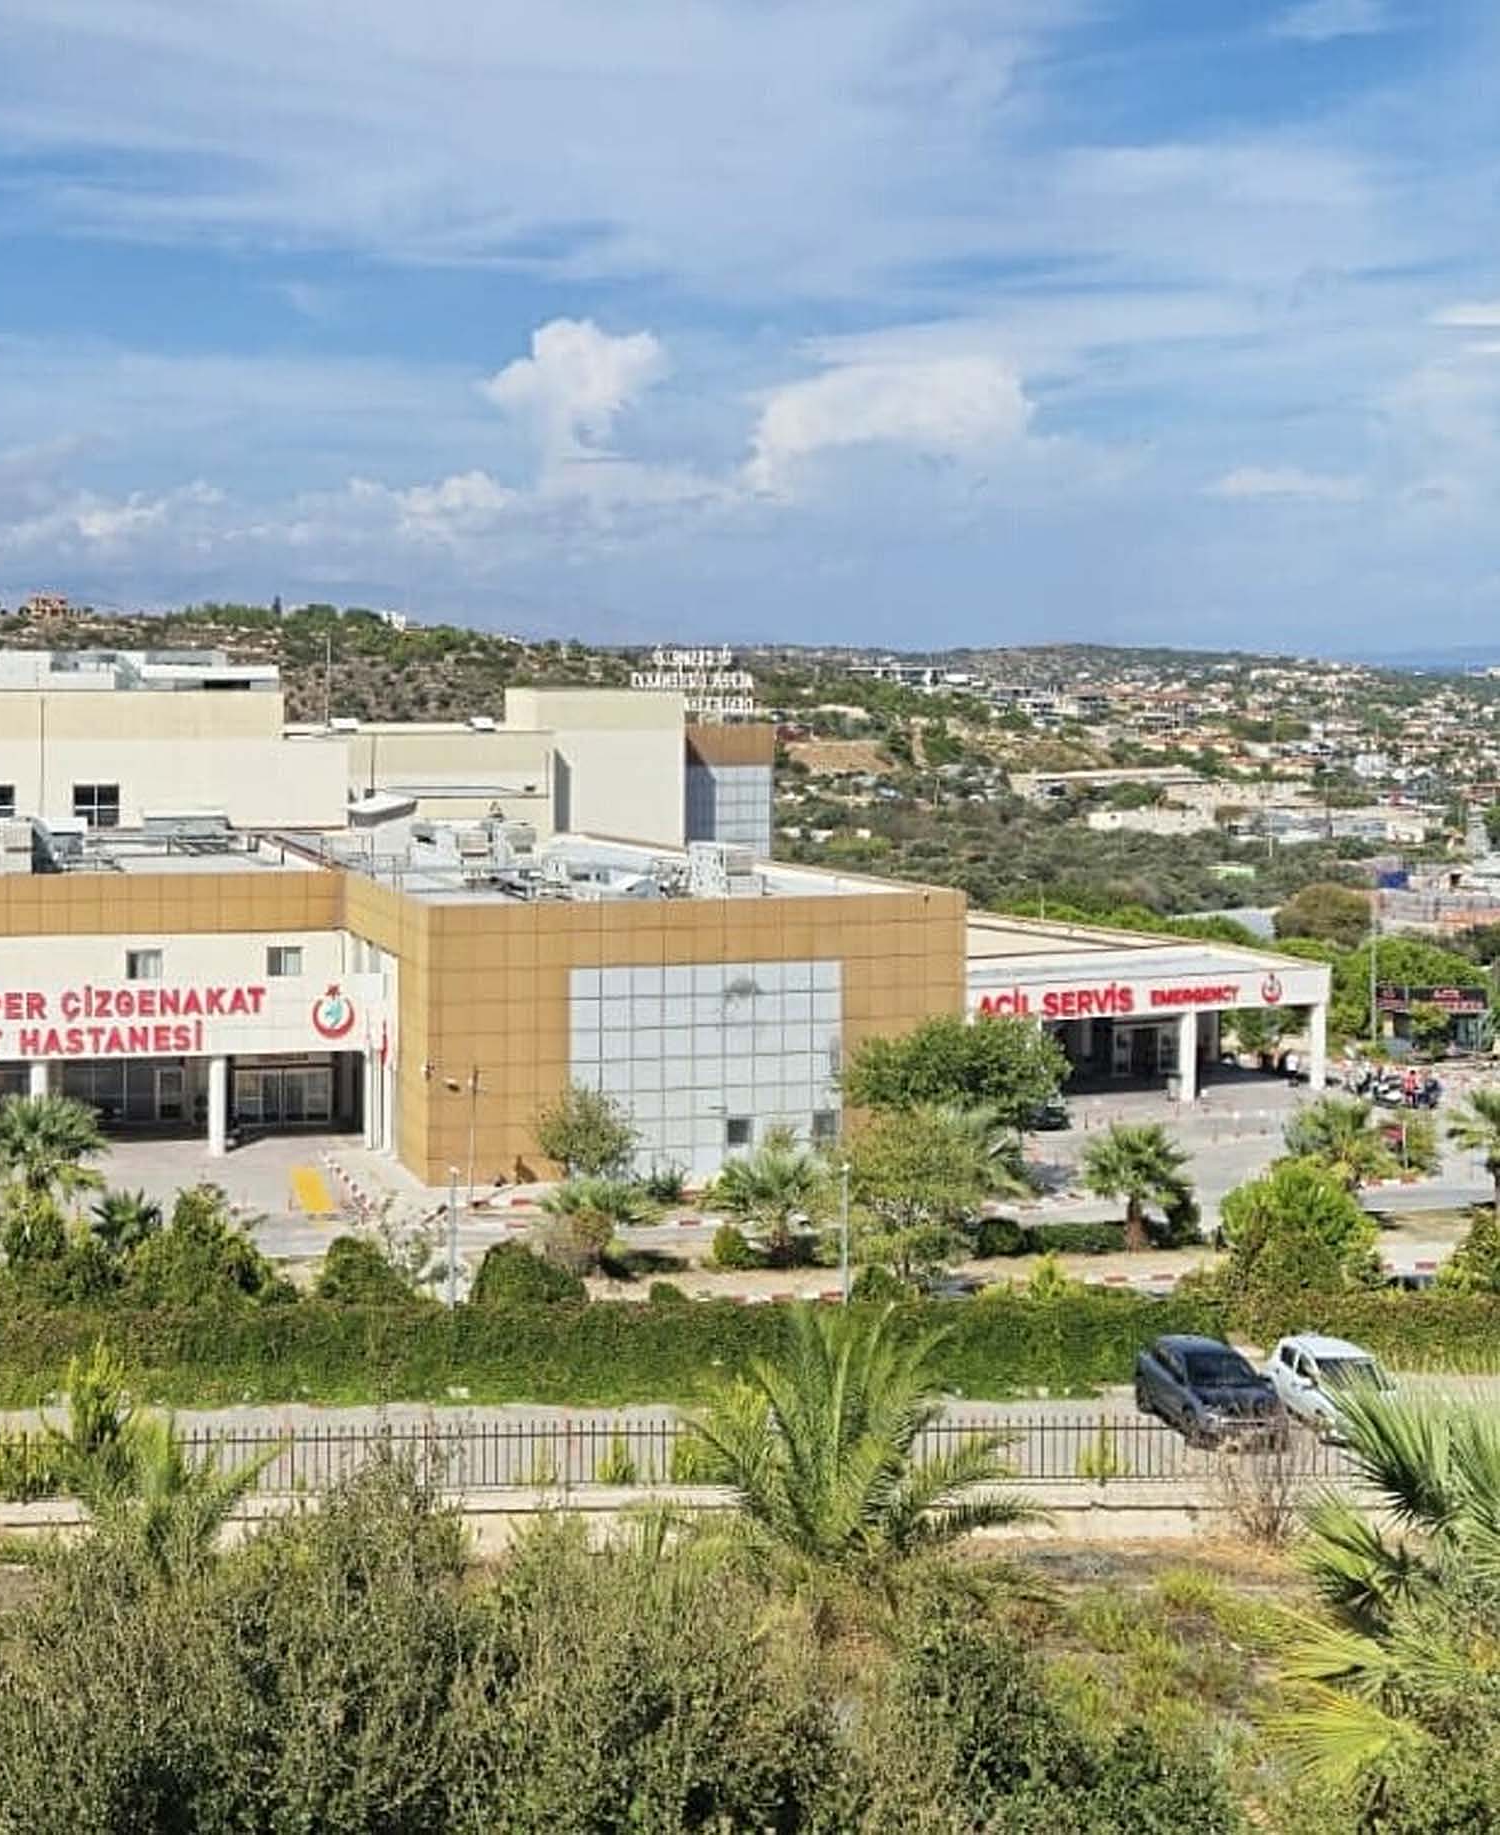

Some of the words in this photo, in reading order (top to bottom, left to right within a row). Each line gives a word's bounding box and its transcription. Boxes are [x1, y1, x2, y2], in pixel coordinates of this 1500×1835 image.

[60, 985, 266, 1022] ÇİZGENAKAT
[1042, 983, 1134, 1017] SERVİS
[1150, 985, 1240, 1006] EMERGENCY
[19, 1020, 204, 1055] HASTANESİ
